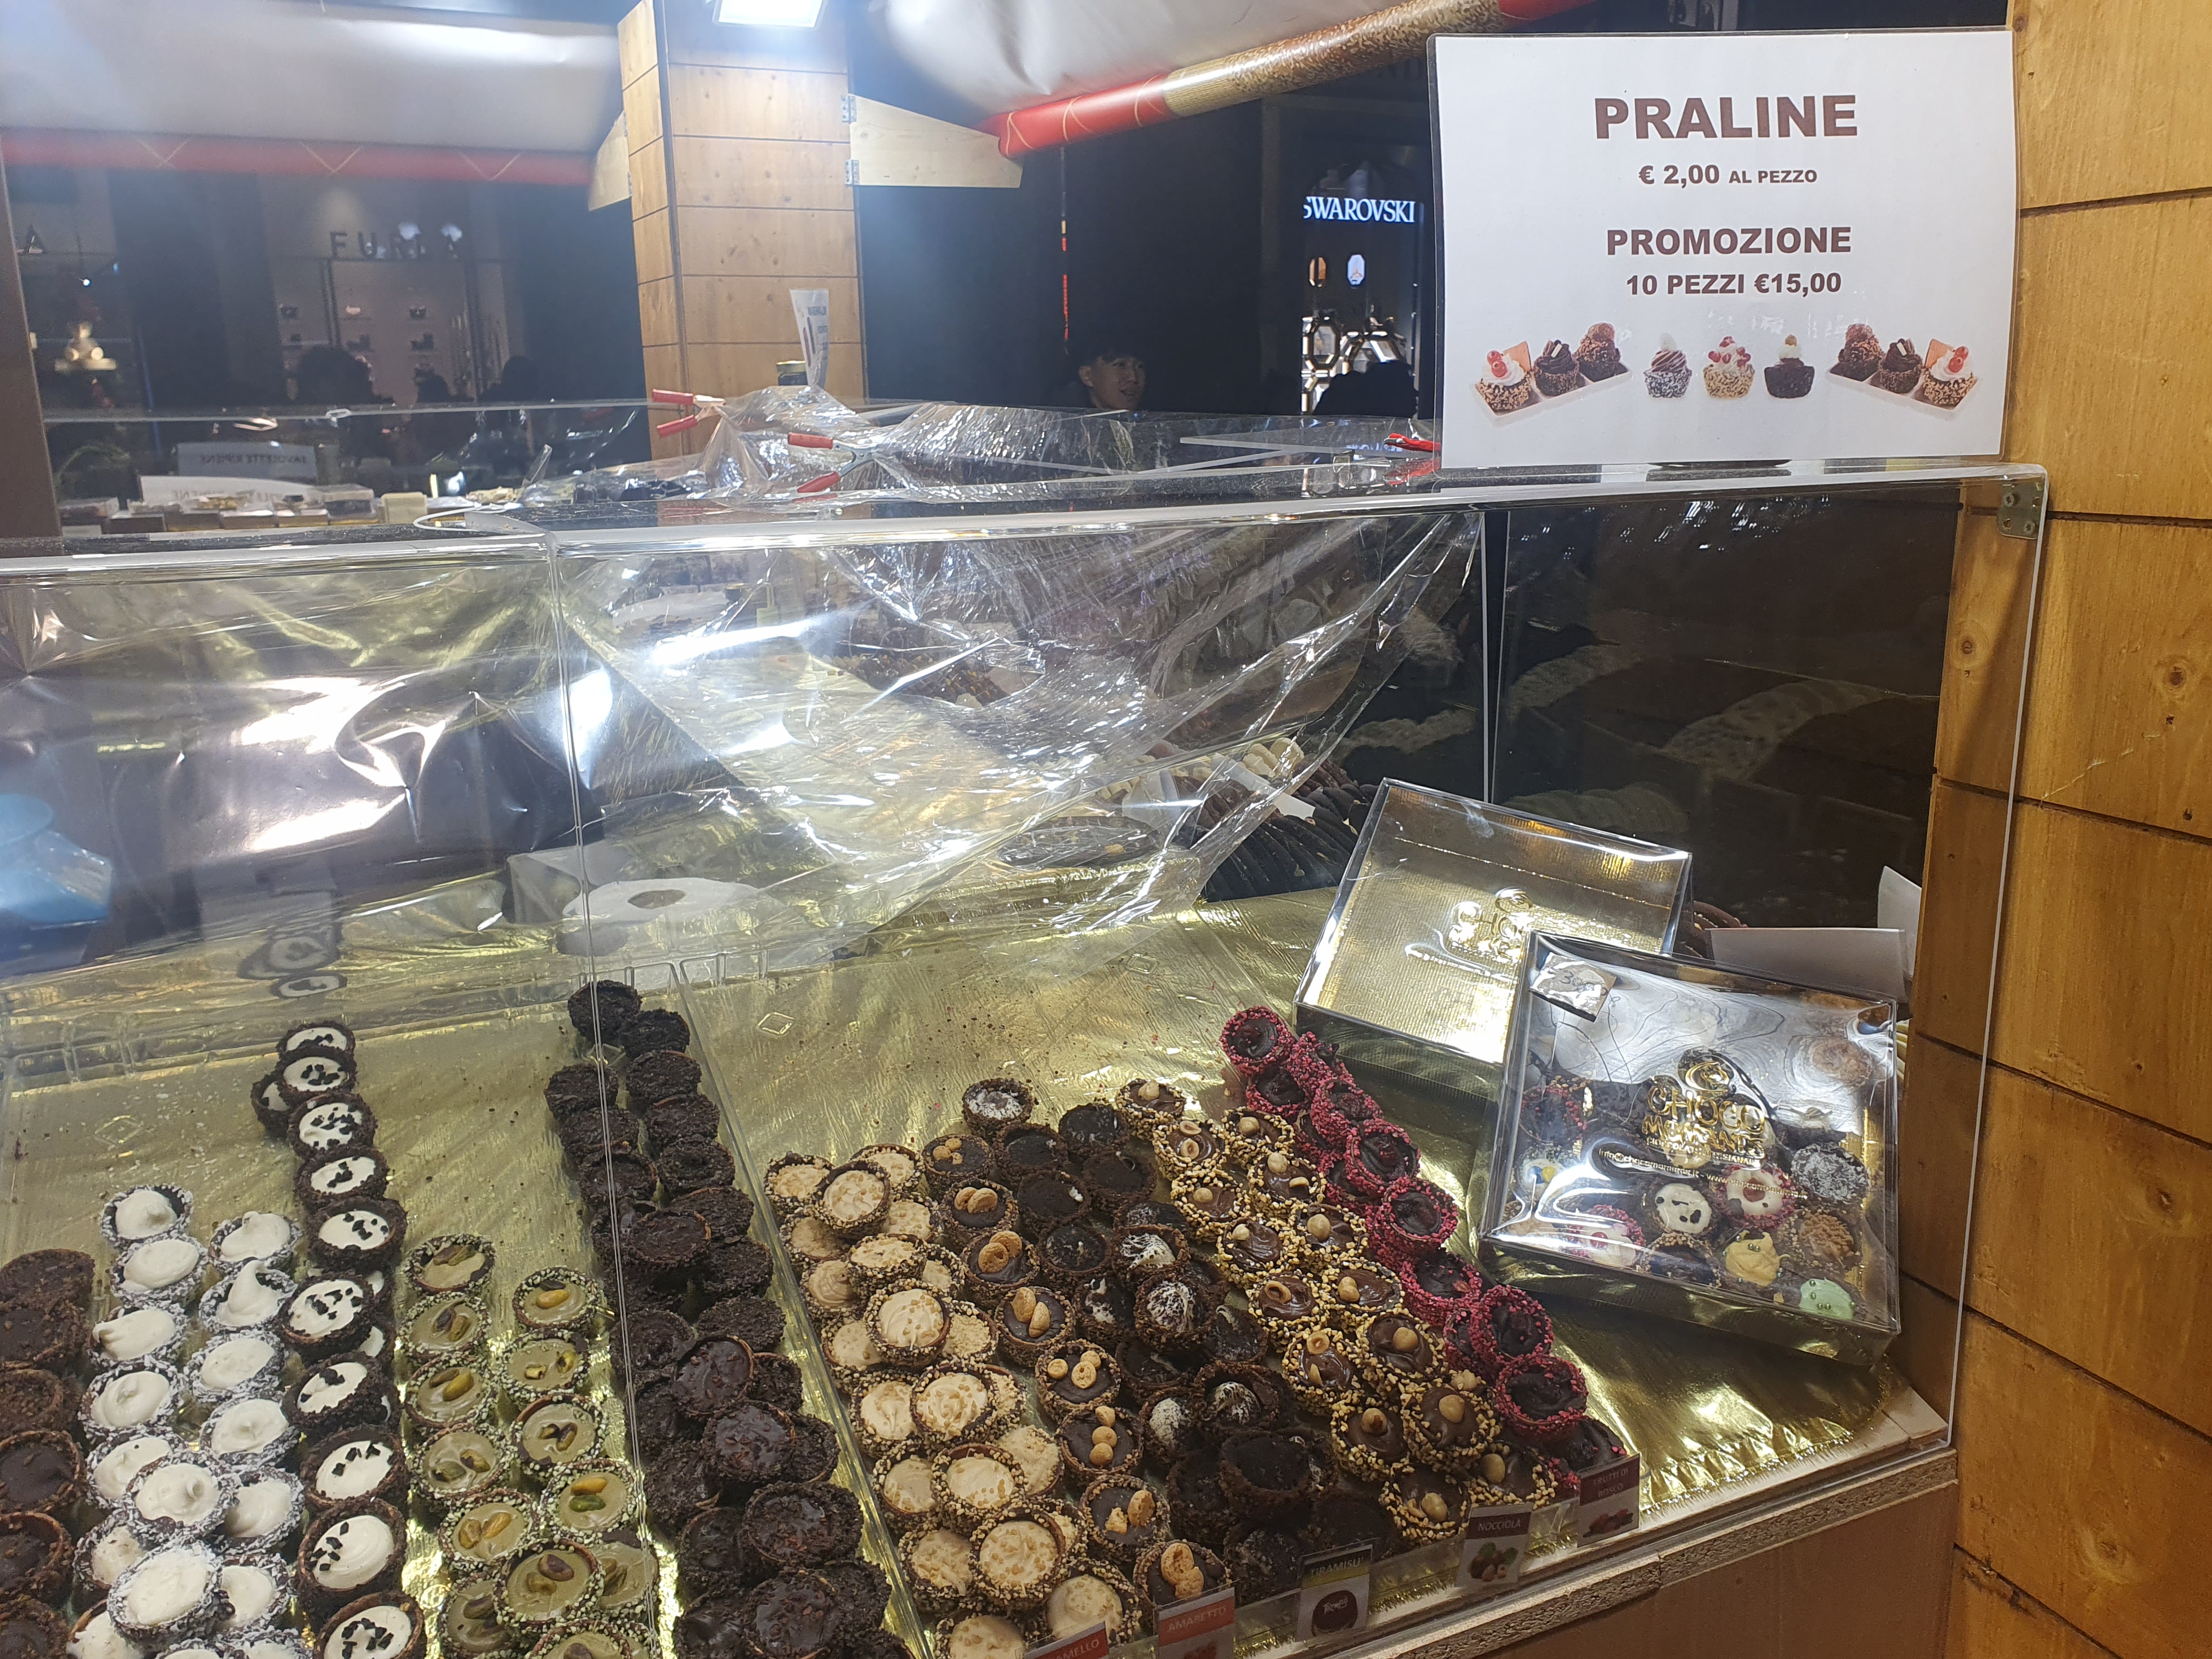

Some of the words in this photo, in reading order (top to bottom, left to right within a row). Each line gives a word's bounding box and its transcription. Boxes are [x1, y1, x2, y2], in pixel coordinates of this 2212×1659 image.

[1595, 95, 1858, 139] PRALINE
[1639, 165, 1655, 184] €
[1664, 165, 1719, 189] 2,00
[1729, 171, 1752, 183] AL
[1758, 170, 1817, 183] PEZZO
[1304, 196, 1416, 223] SWAROVSKI
[1607, 227, 1851, 255] PROMOZIONE
[1627, 275, 1657, 295] 10
[1668, 274, 1744, 295] PEZZI
[1754, 272, 1841, 298] €15,00
[1647, 1085, 1765, 1135] CHOCO
[1478, 1519, 1521, 1532] NOCCIOLA
[1168, 1606, 1227, 1632] AMARETTO
